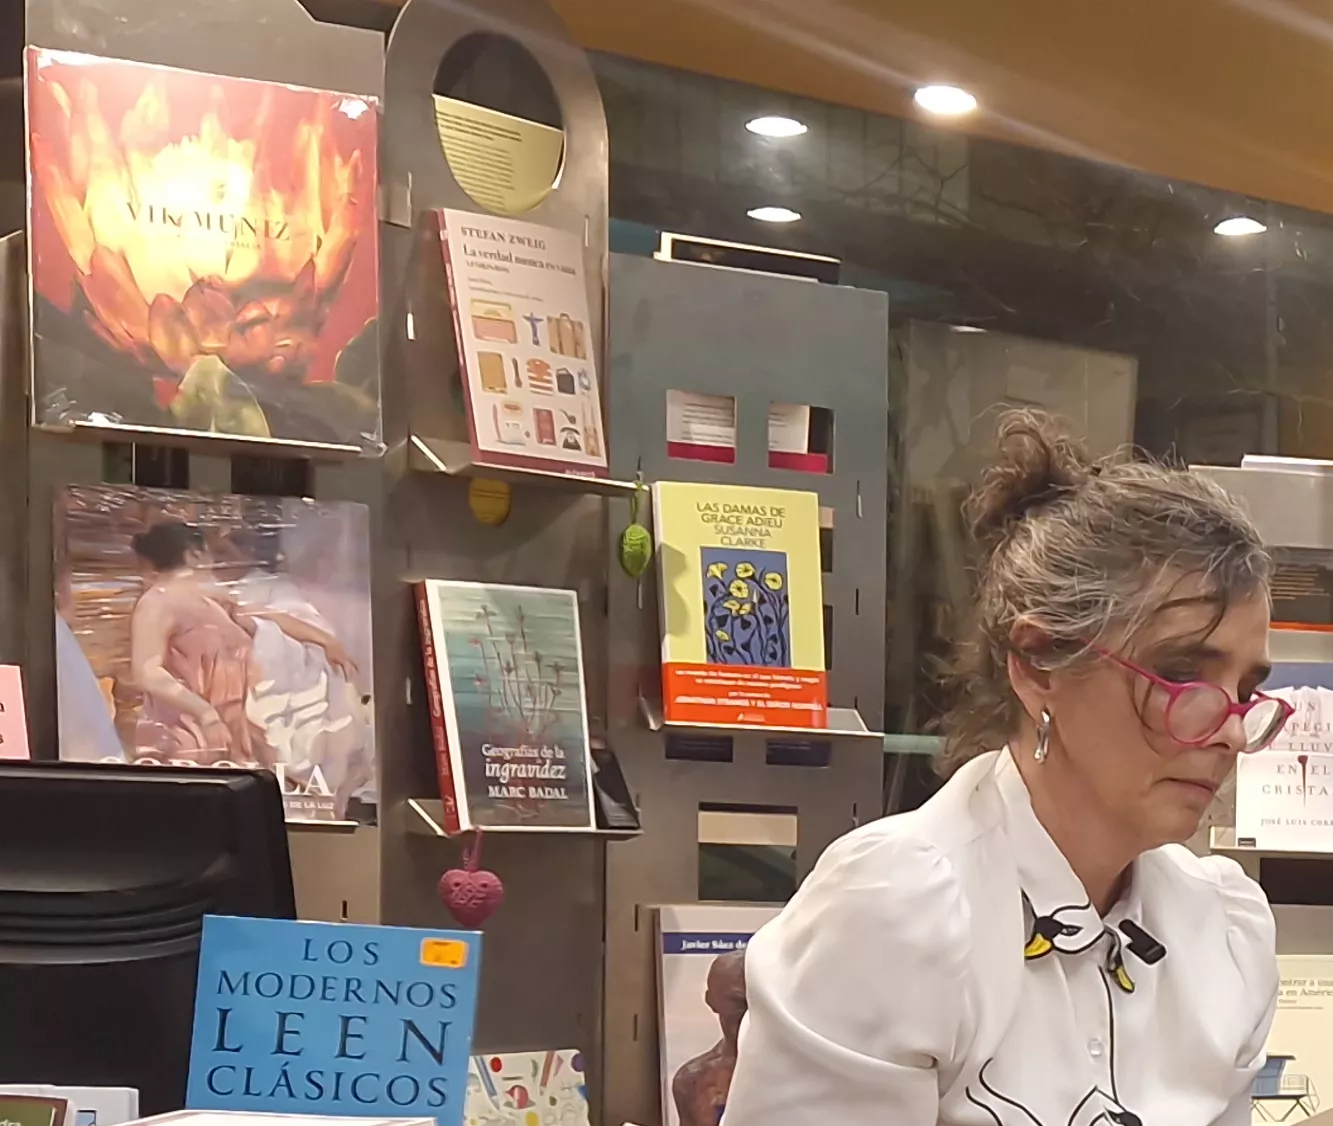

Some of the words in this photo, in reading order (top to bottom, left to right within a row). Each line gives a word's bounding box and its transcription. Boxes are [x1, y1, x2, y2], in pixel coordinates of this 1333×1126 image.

[461, 226, 506, 244] STEFAN
[508, 233, 546, 250] ZWEIG
[697, 502, 720, 515] LAS
[722, 503, 767, 517] DAMAS
[770, 505, 786, 518] DE
[701, 512, 743, 526] GRACE
[745, 514, 783, 529] ADIEU
[713, 524, 772, 538] SUSANNA
[720, 535, 767, 549] CLARKE
[541, 745, 553, 760] de
[554, 745, 566, 760] la
[484, 759, 567, 781] ingravidez
[1276, 763, 1298, 776] EN
[1309, 763, 1331, 776] EL
[488, 785, 525, 799] MARC
[528, 786, 569, 800] BADAL
[301, 937, 380, 967] LOS
[215, 970, 457, 1011] MODERNOS
[211, 1006, 454, 1068] LEEN
[206, 1061, 448, 1108] CLÁSICOS
